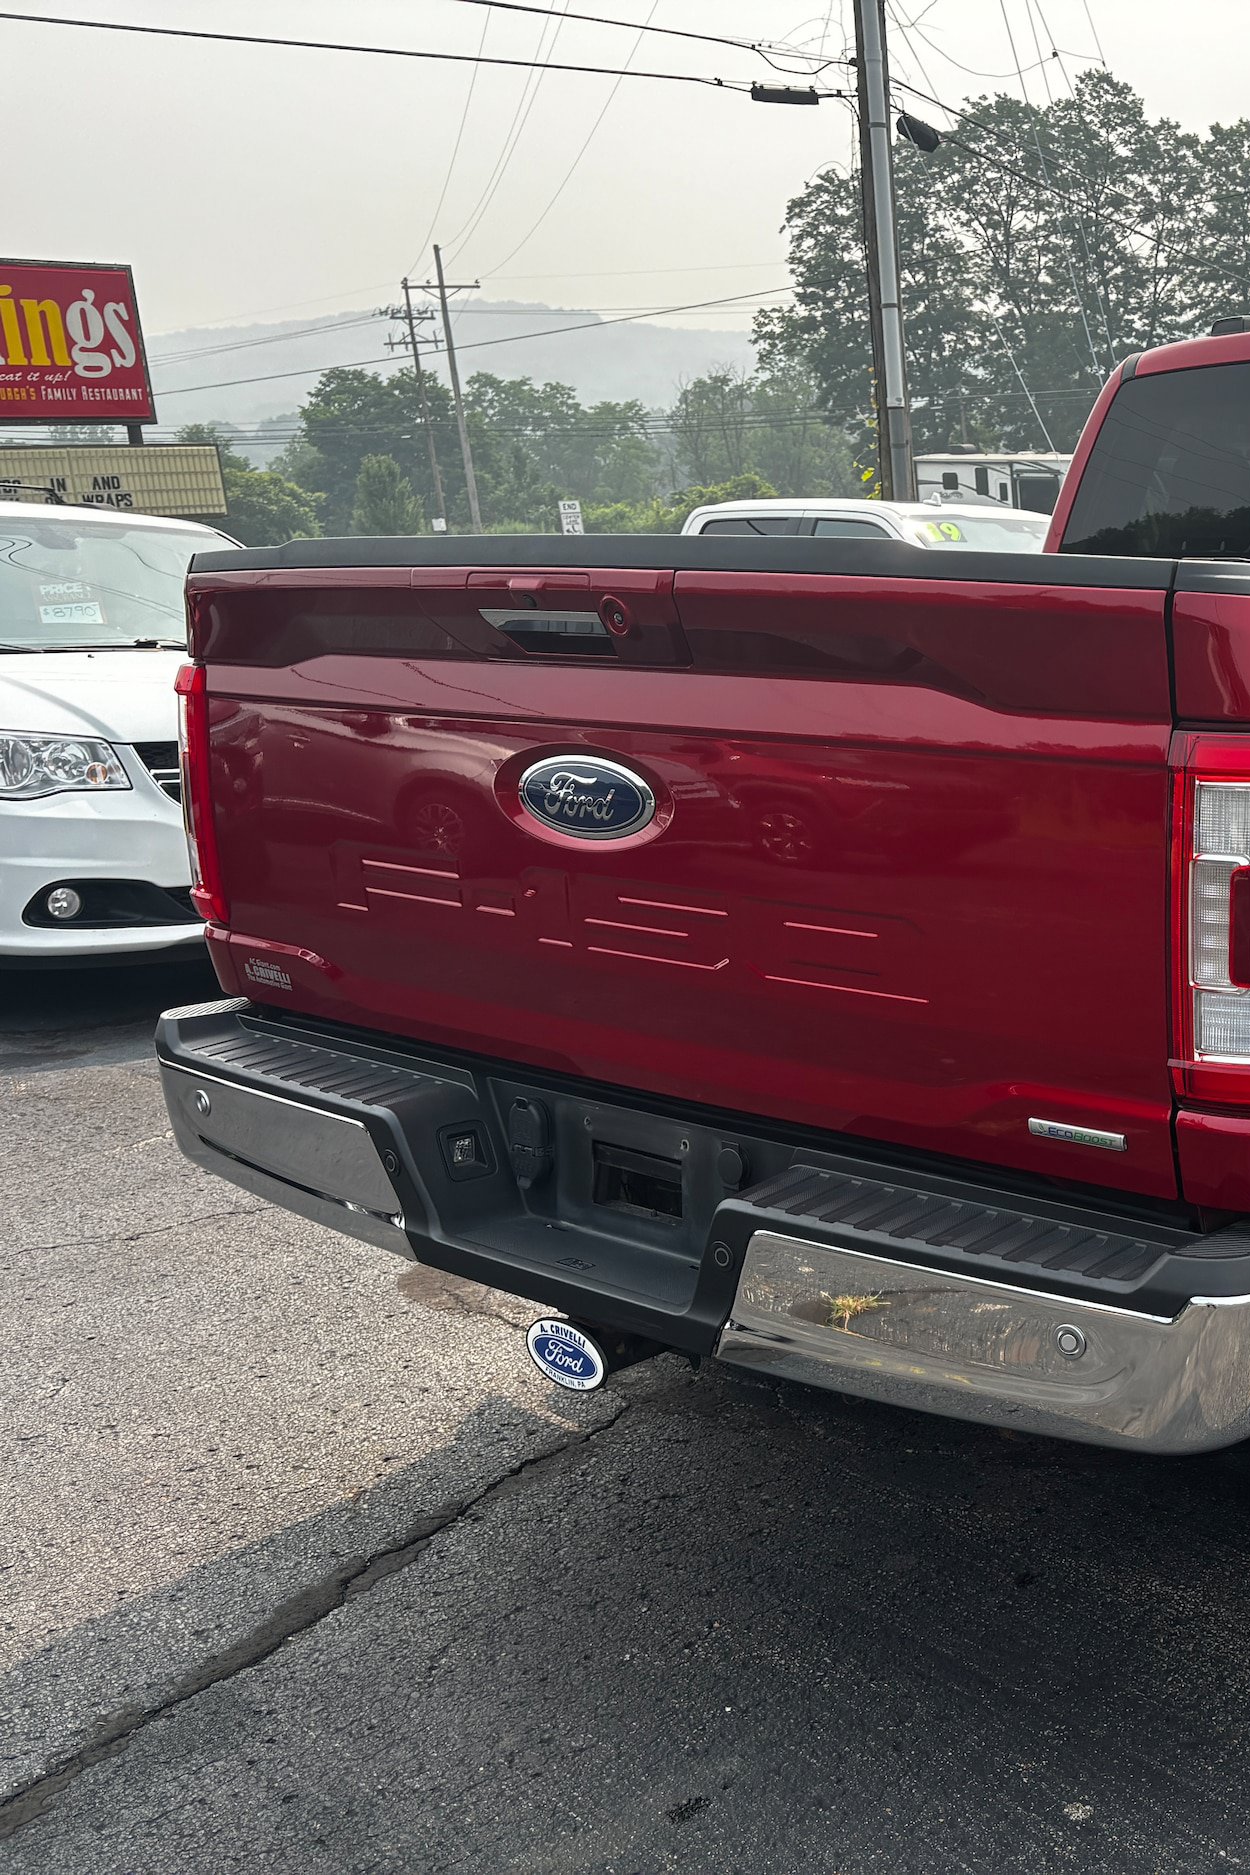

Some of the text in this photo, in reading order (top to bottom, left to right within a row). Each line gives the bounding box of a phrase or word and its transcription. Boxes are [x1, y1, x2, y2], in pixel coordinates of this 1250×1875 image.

[0, 285, 136, 378] ings
[27, 372, 40, 381] it
[44, 371, 72, 384] up!
[41, 386, 77, 400] FAMILY
[81, 386, 143, 400] RESTAURANT
[92, 476, 121, 490] AND
[83, 493, 133, 507] WRAPS
[39, 582, 83, 595] PRICE
[543, 771, 616, 820] Ford
[253, 965, 292, 985] CRIVELLI
[540, 1323, 586, 1348] A. CRIVELLI
[545, 1340, 584, 1374] Ford
